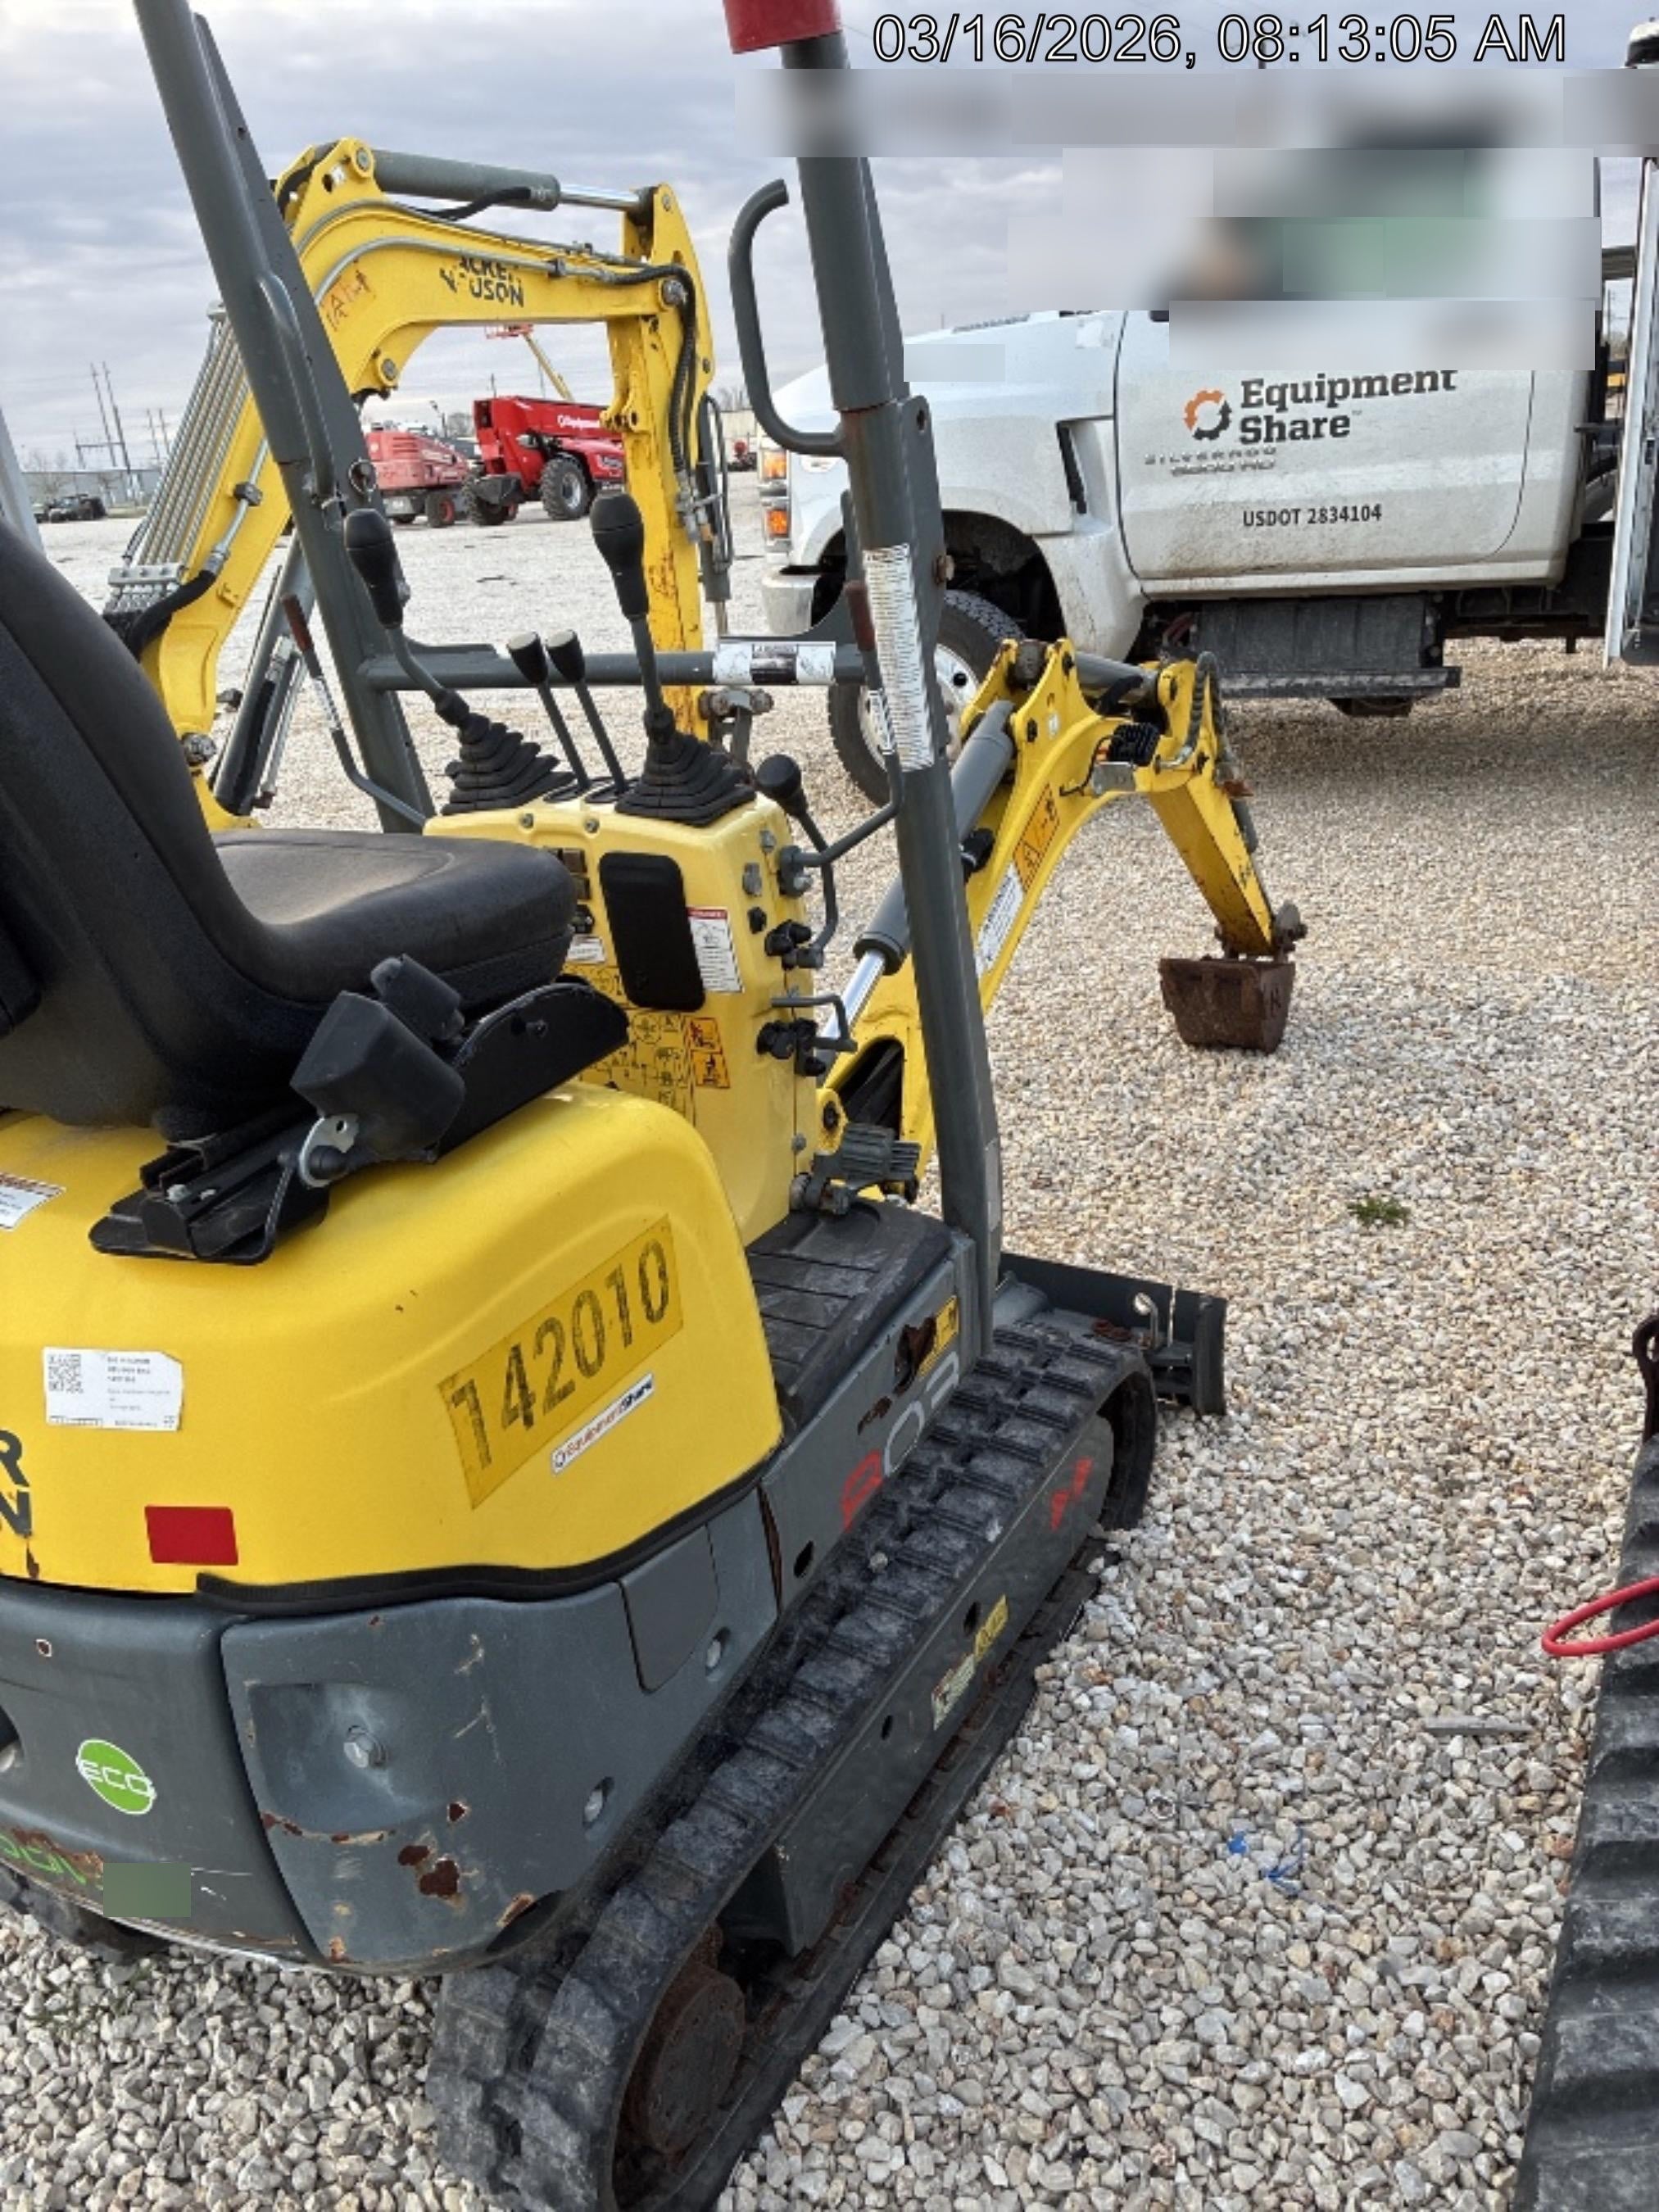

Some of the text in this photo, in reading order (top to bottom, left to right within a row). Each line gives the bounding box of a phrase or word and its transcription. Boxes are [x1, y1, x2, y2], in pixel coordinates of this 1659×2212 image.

[1240, 370, 1458, 412] Equipment
[1240, 413, 1351, 445] Share
[1243, 502, 1382, 528] USDOT 2834104
[451, 1240, 669, 1470] 142010
[75, 1754, 157, 1801] ECO
